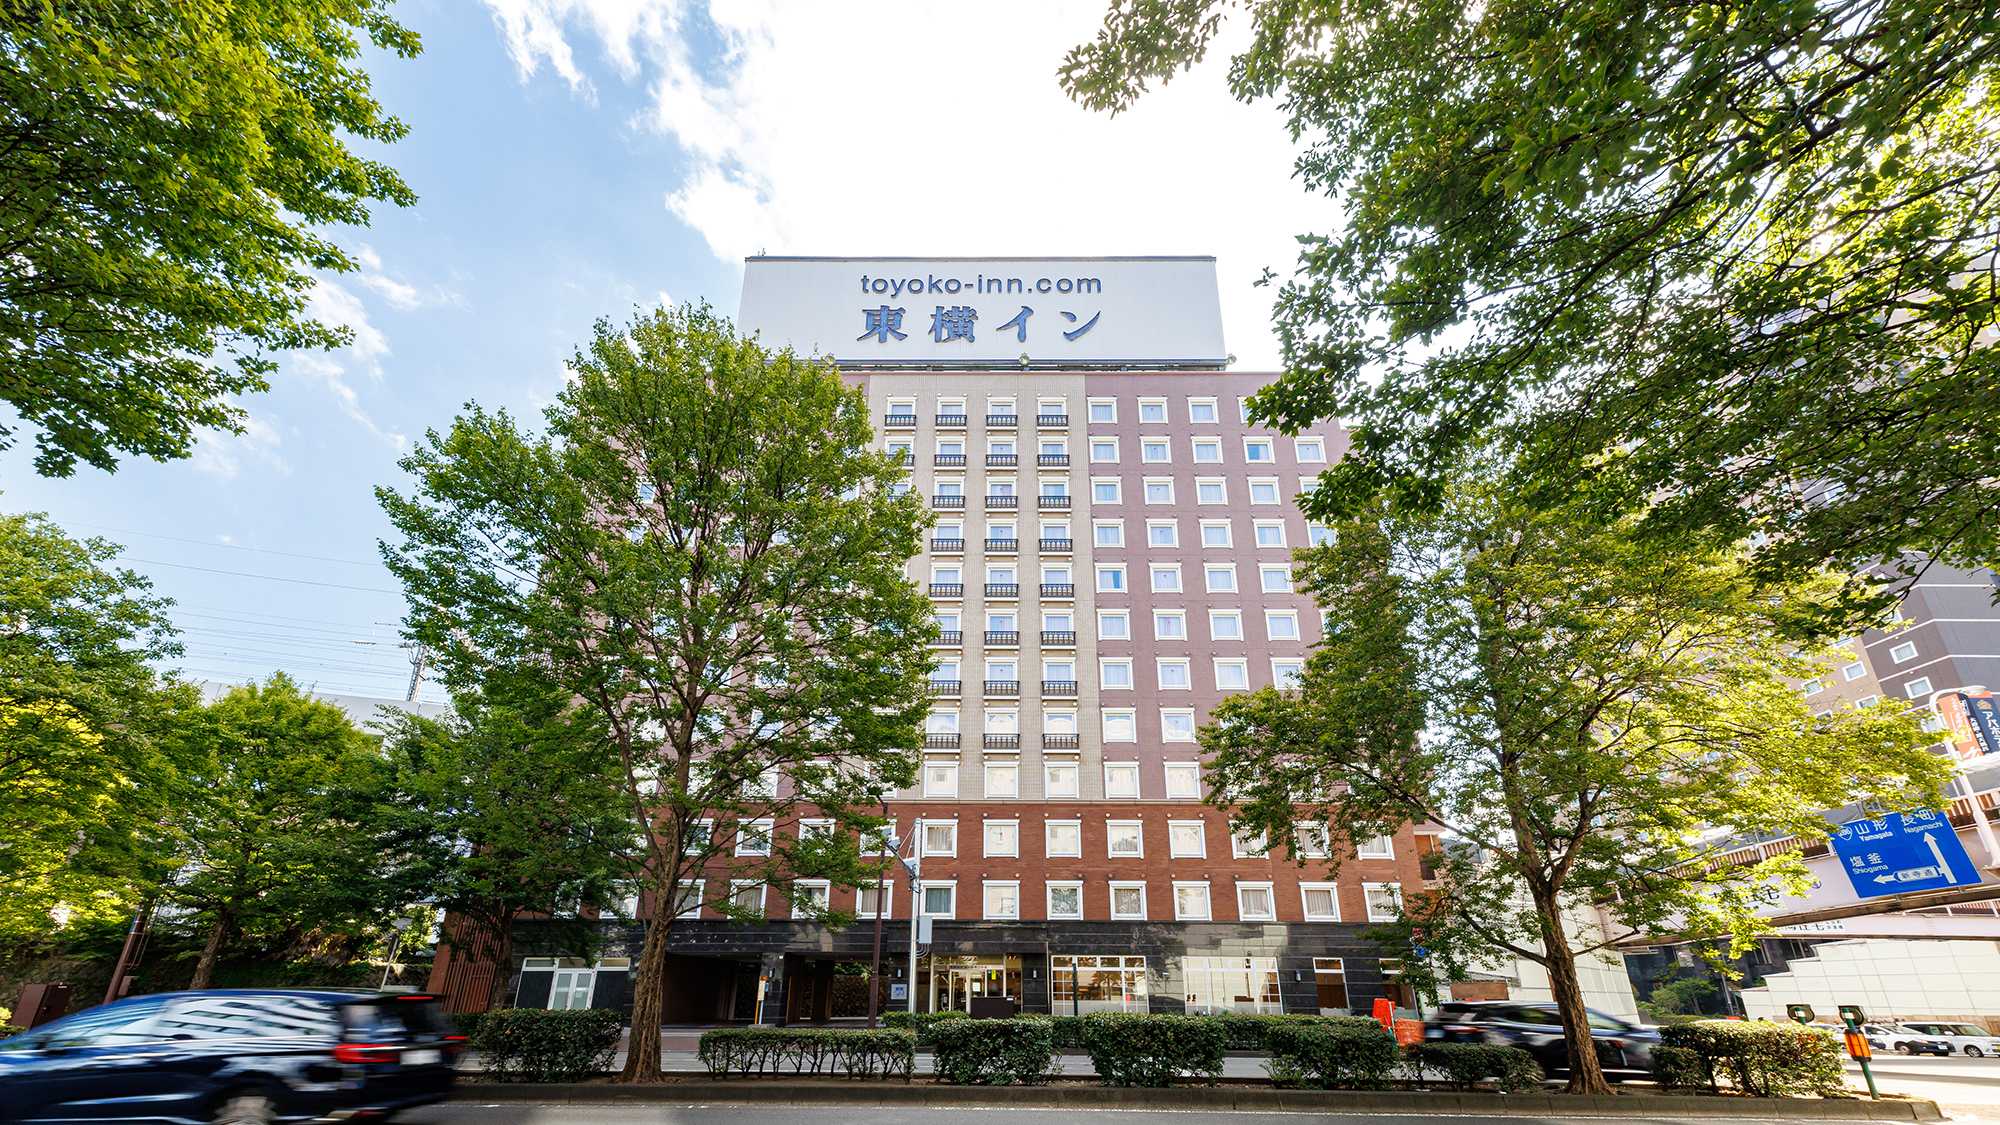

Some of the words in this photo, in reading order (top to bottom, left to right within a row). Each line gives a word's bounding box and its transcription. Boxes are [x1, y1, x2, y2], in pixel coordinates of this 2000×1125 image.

[861, 274, 1102, 298] toyoko-inn.com
[857, 305, 1102, 343] 東横イン
[1855, 818, 1887, 835] 山形
[1903, 822, 1943, 834] Nagamachi
[1859, 831, 1894, 842] Yamagata
[1850, 852, 1883, 867] 塩釜
[1852, 864, 1889, 874] Shiogama
